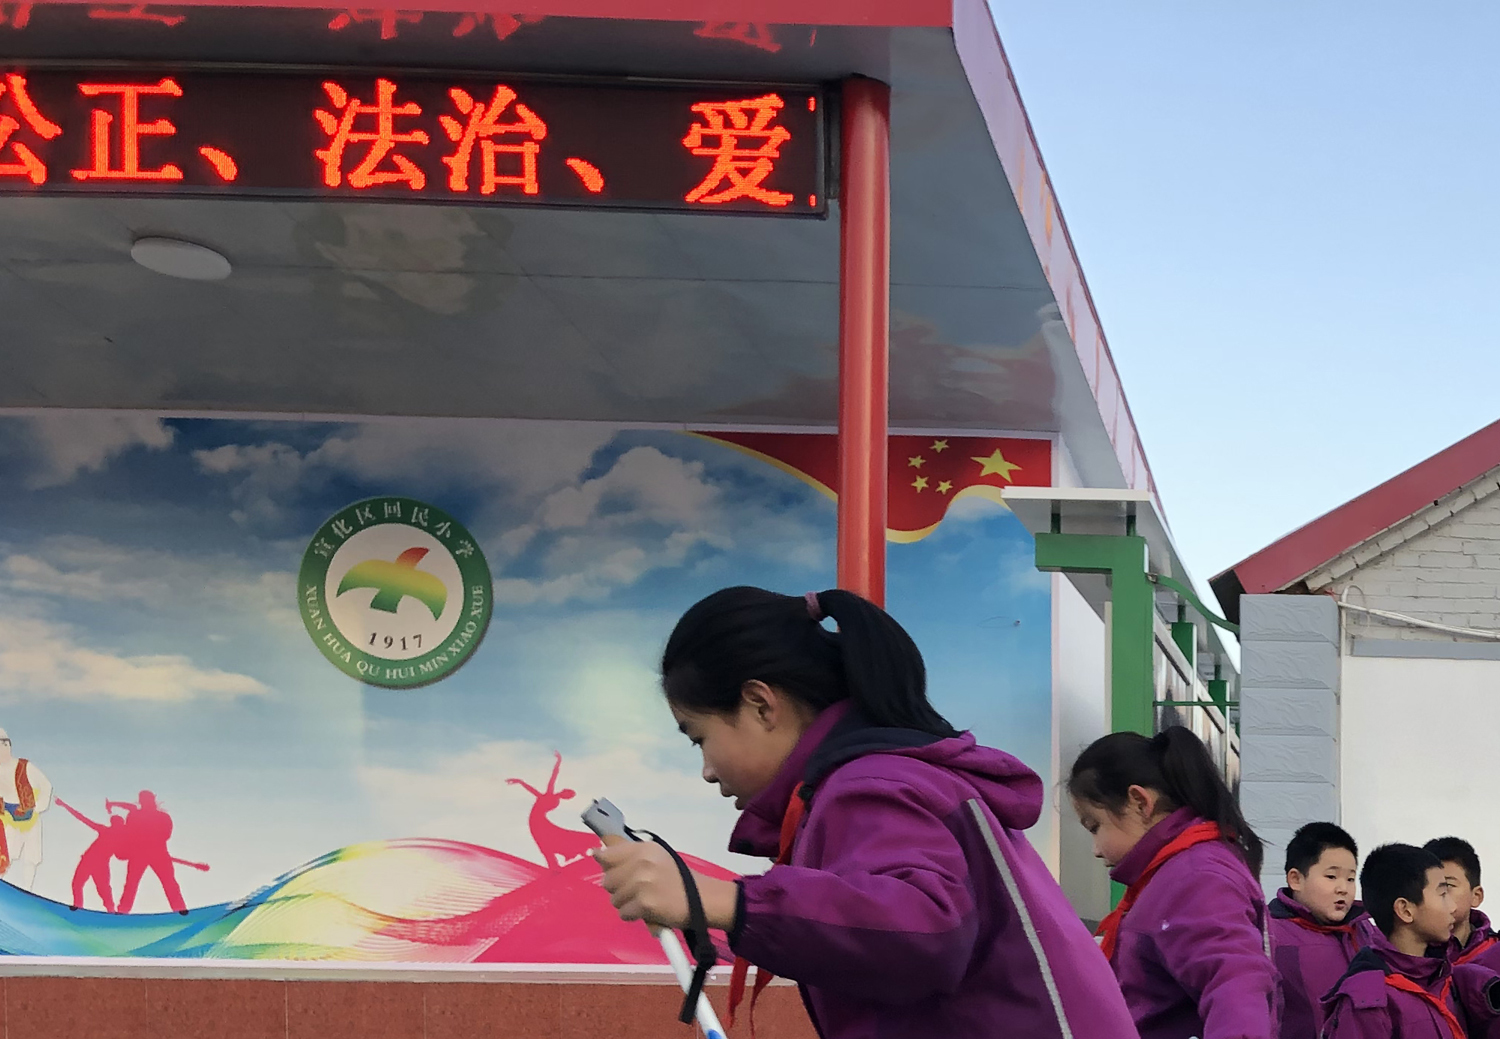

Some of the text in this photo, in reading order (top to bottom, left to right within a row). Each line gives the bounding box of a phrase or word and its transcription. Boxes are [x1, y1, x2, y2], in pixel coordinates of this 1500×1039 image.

[314, 501, 475, 560] 宣化区回民小学
[306, 584, 484, 680] XUAN HUA QU HUI MIN XIAO XUE
[368, 631, 423, 651] 1917
